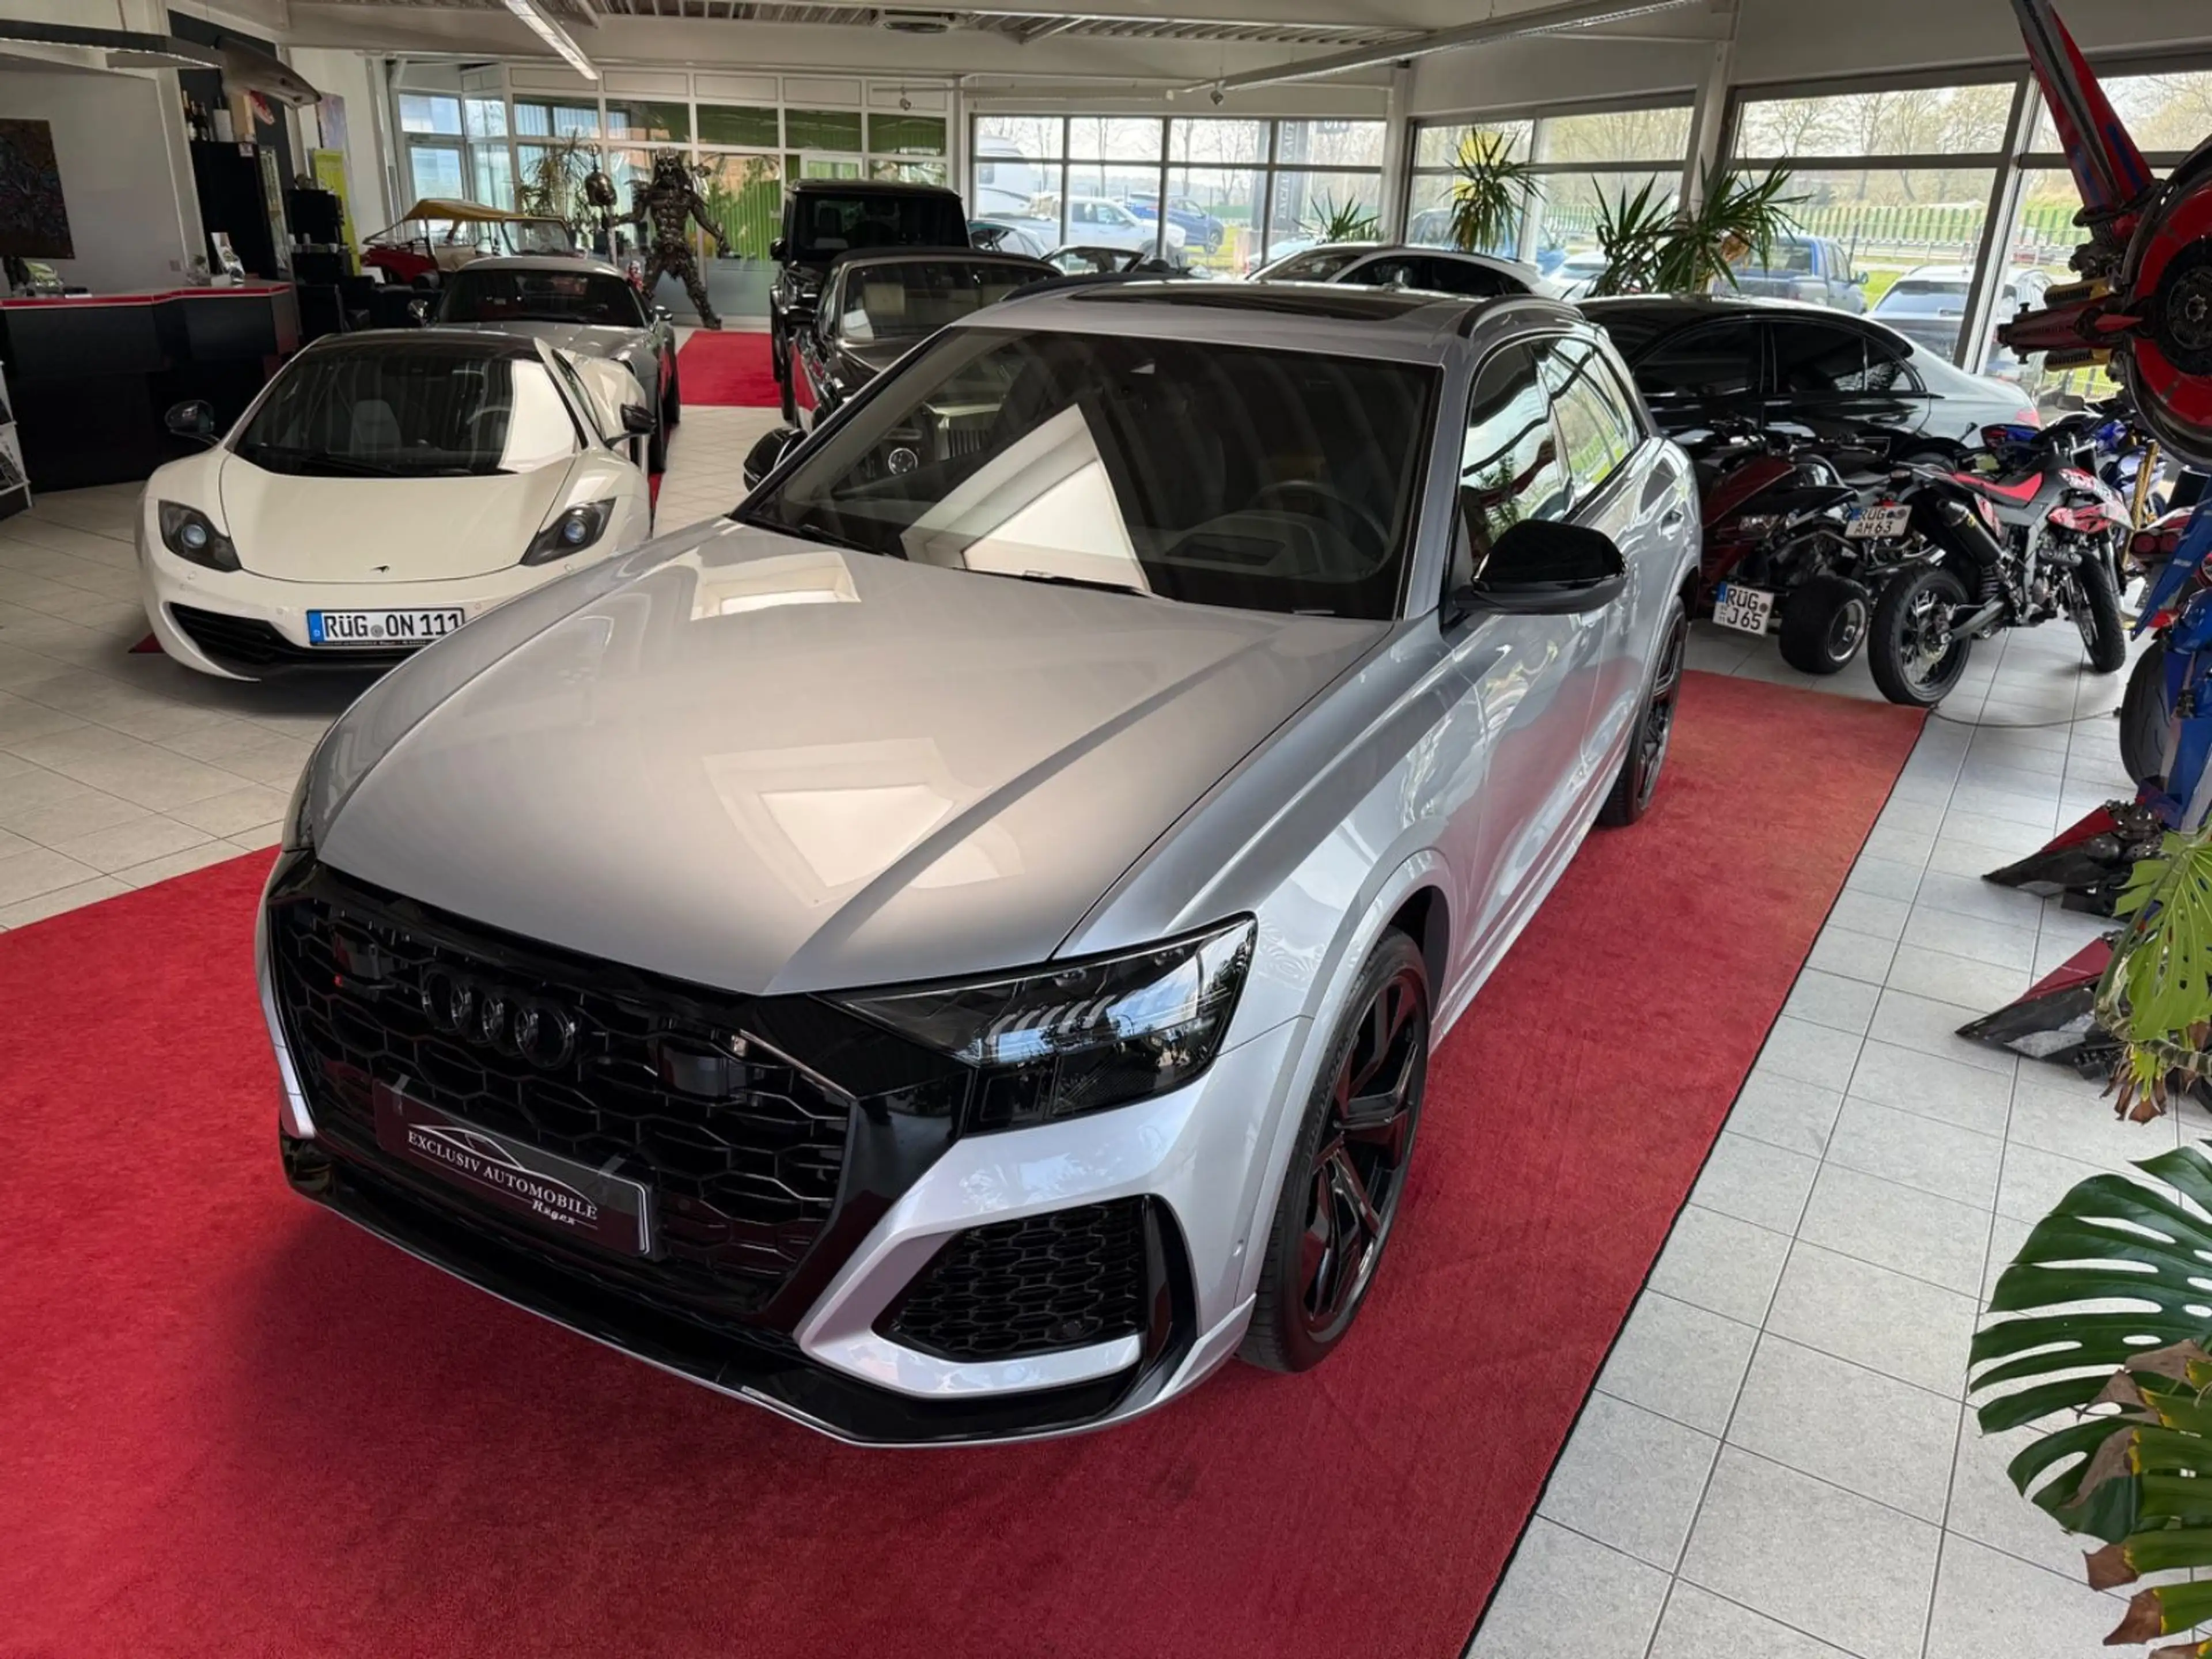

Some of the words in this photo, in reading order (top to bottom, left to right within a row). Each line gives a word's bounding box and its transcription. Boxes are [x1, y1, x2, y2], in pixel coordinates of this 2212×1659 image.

[1278, 152, 1293, 219] EXCLUV
[324, 615, 369, 638] RÜG
[385, 614, 415, 637] ON
[420, 613, 460, 636] 111
[408, 1130, 480, 1172] EXCLUSIV
[483, 1165, 598, 1221] AUTOMOBILE
